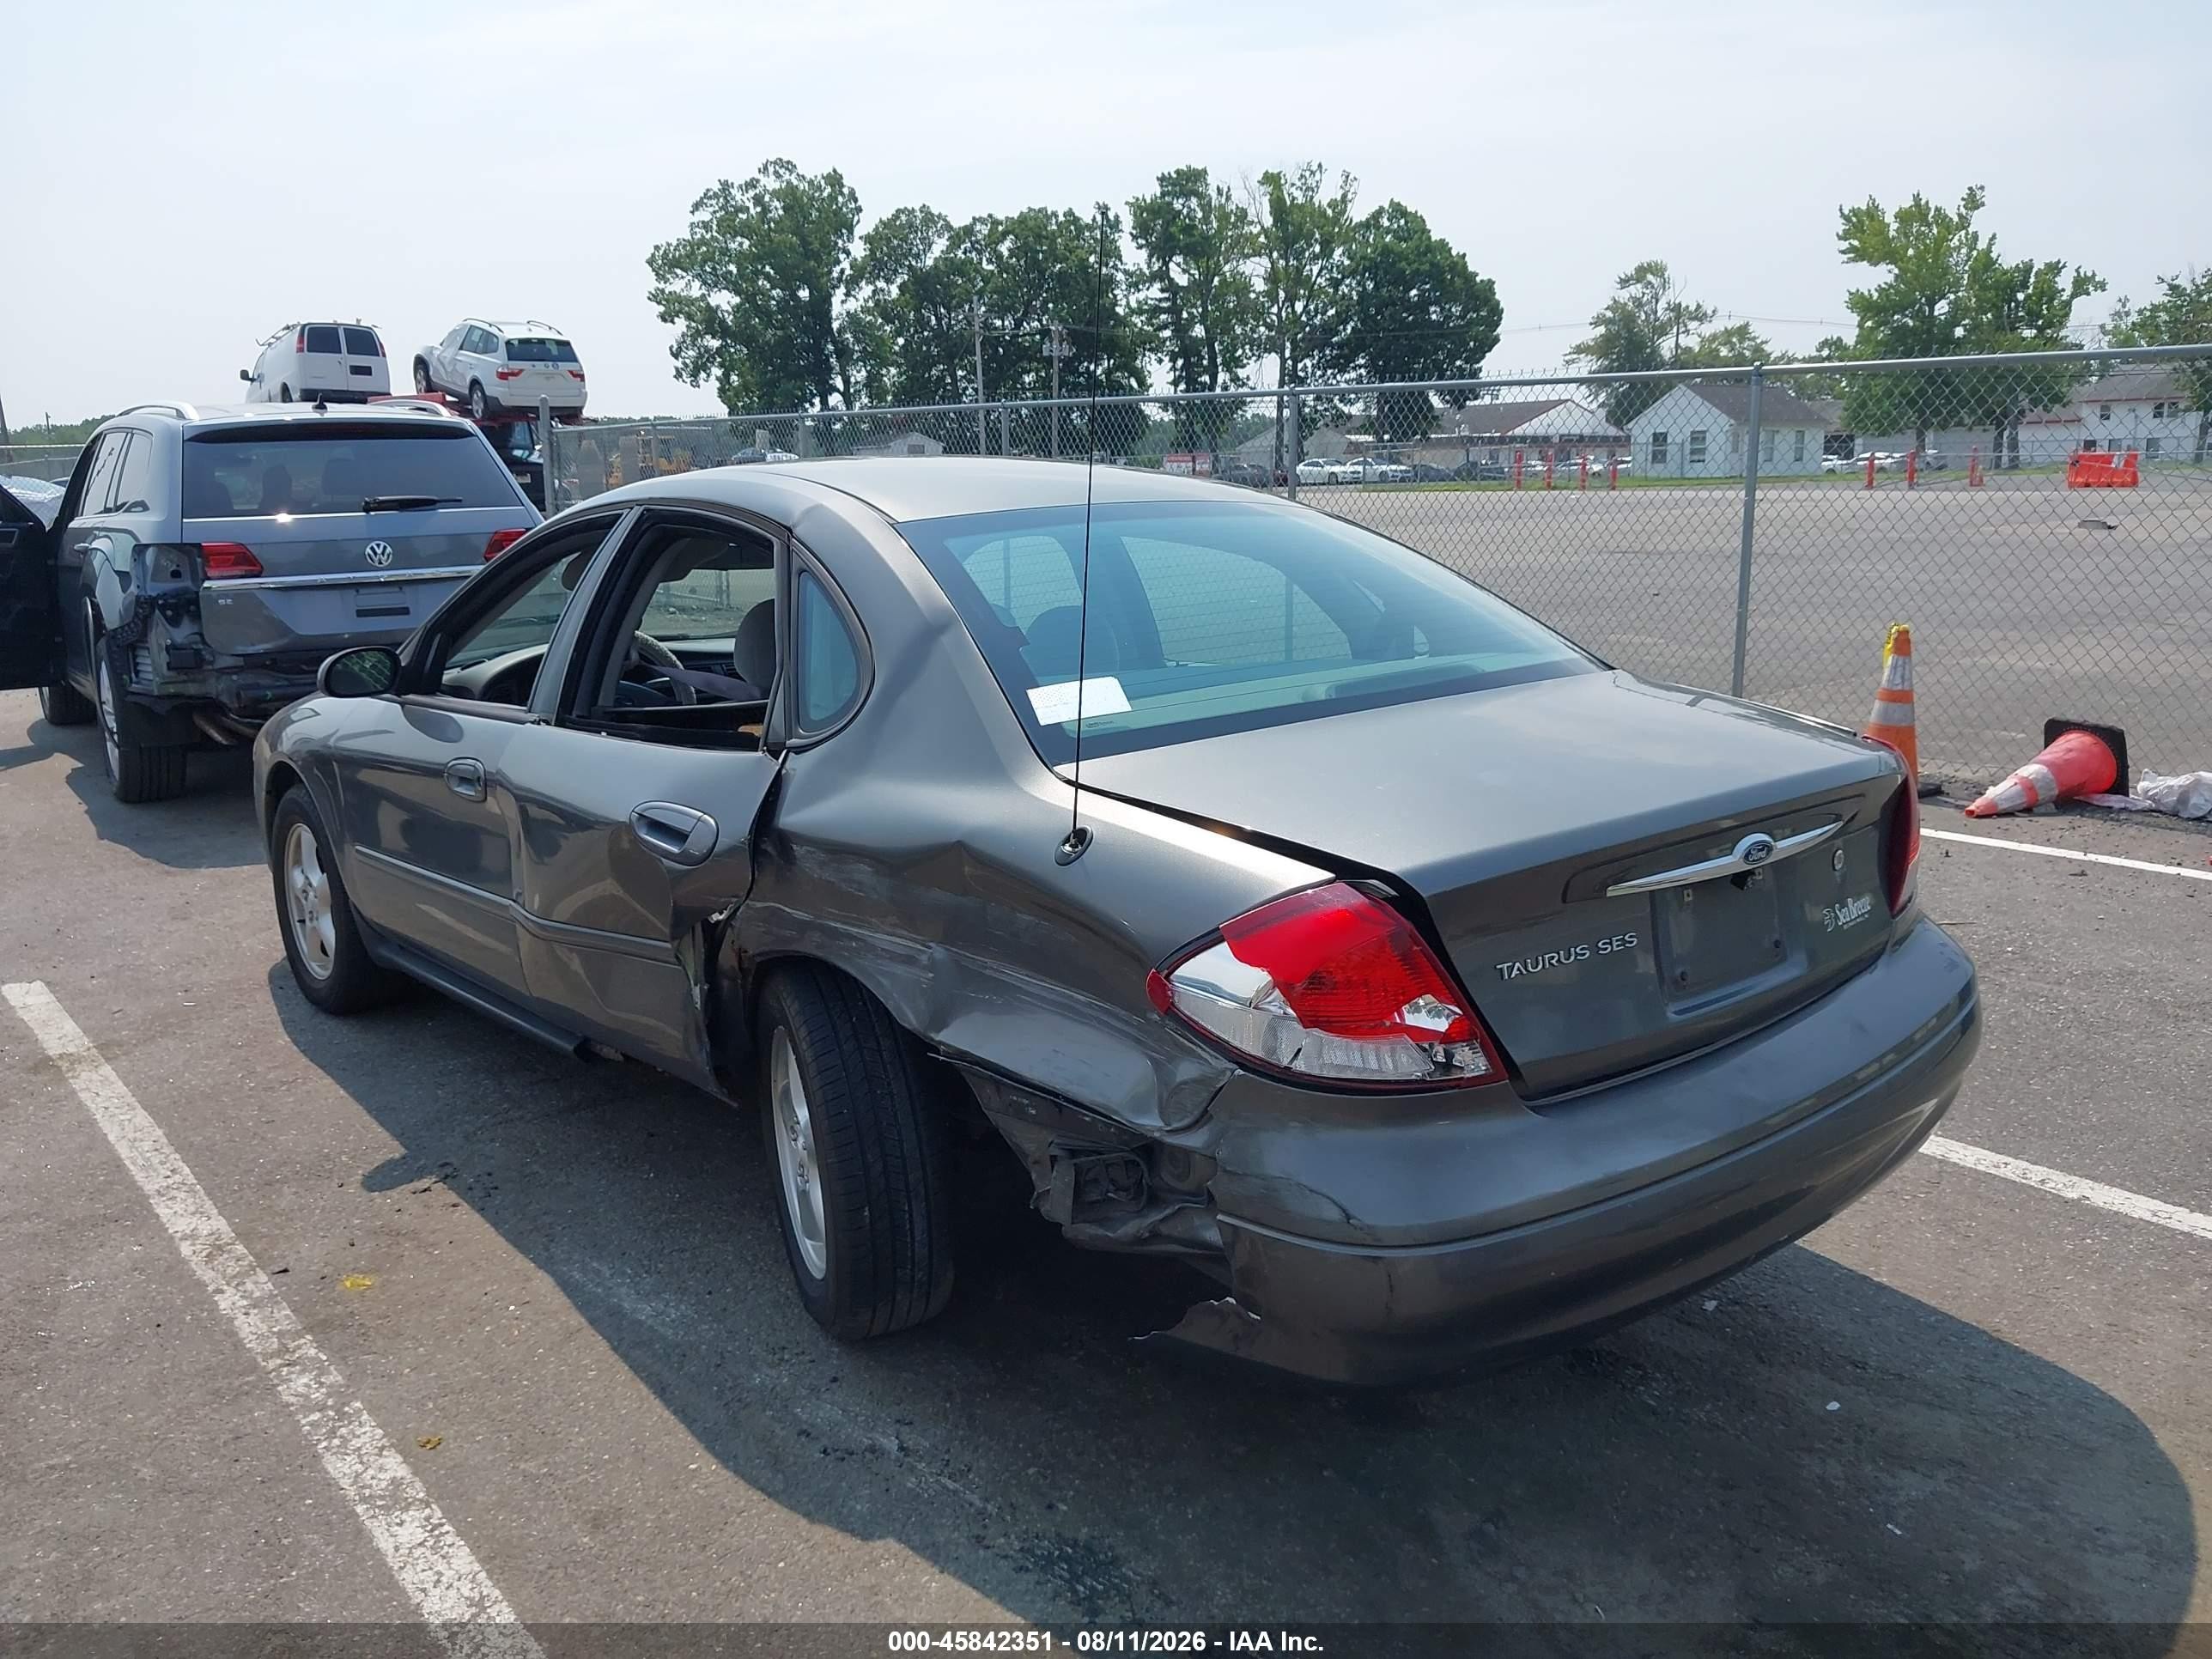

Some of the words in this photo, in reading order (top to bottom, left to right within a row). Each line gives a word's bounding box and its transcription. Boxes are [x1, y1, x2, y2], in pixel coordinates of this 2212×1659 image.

[365, 541, 392, 567] VW
[1496, 945, 1590, 980] TAURUS
[1597, 933, 1638, 954] SES
